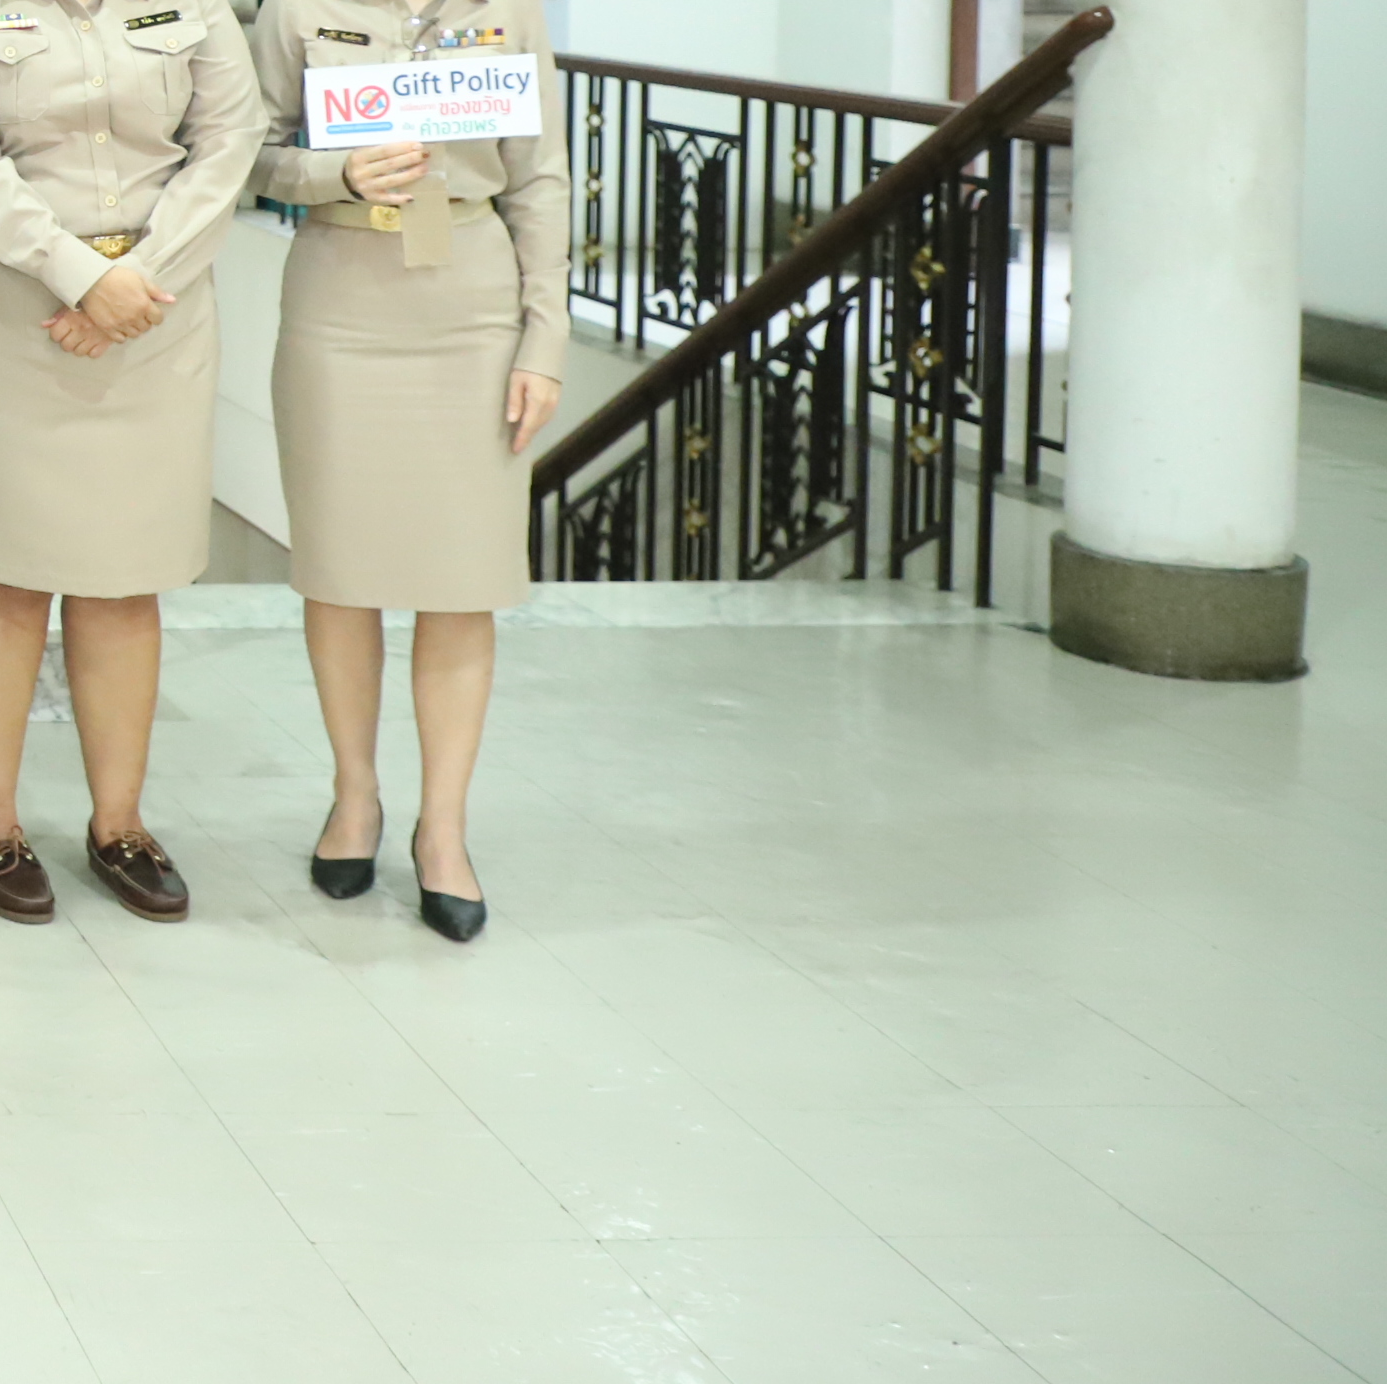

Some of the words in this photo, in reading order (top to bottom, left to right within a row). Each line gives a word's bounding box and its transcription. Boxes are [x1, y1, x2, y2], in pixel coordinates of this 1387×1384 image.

[392, 71, 442, 97] Gift
[450, 68, 531, 95] Policy
[438, 95, 511, 116] ของขวัญ
[420, 117, 497, 136] คำอวยพร
